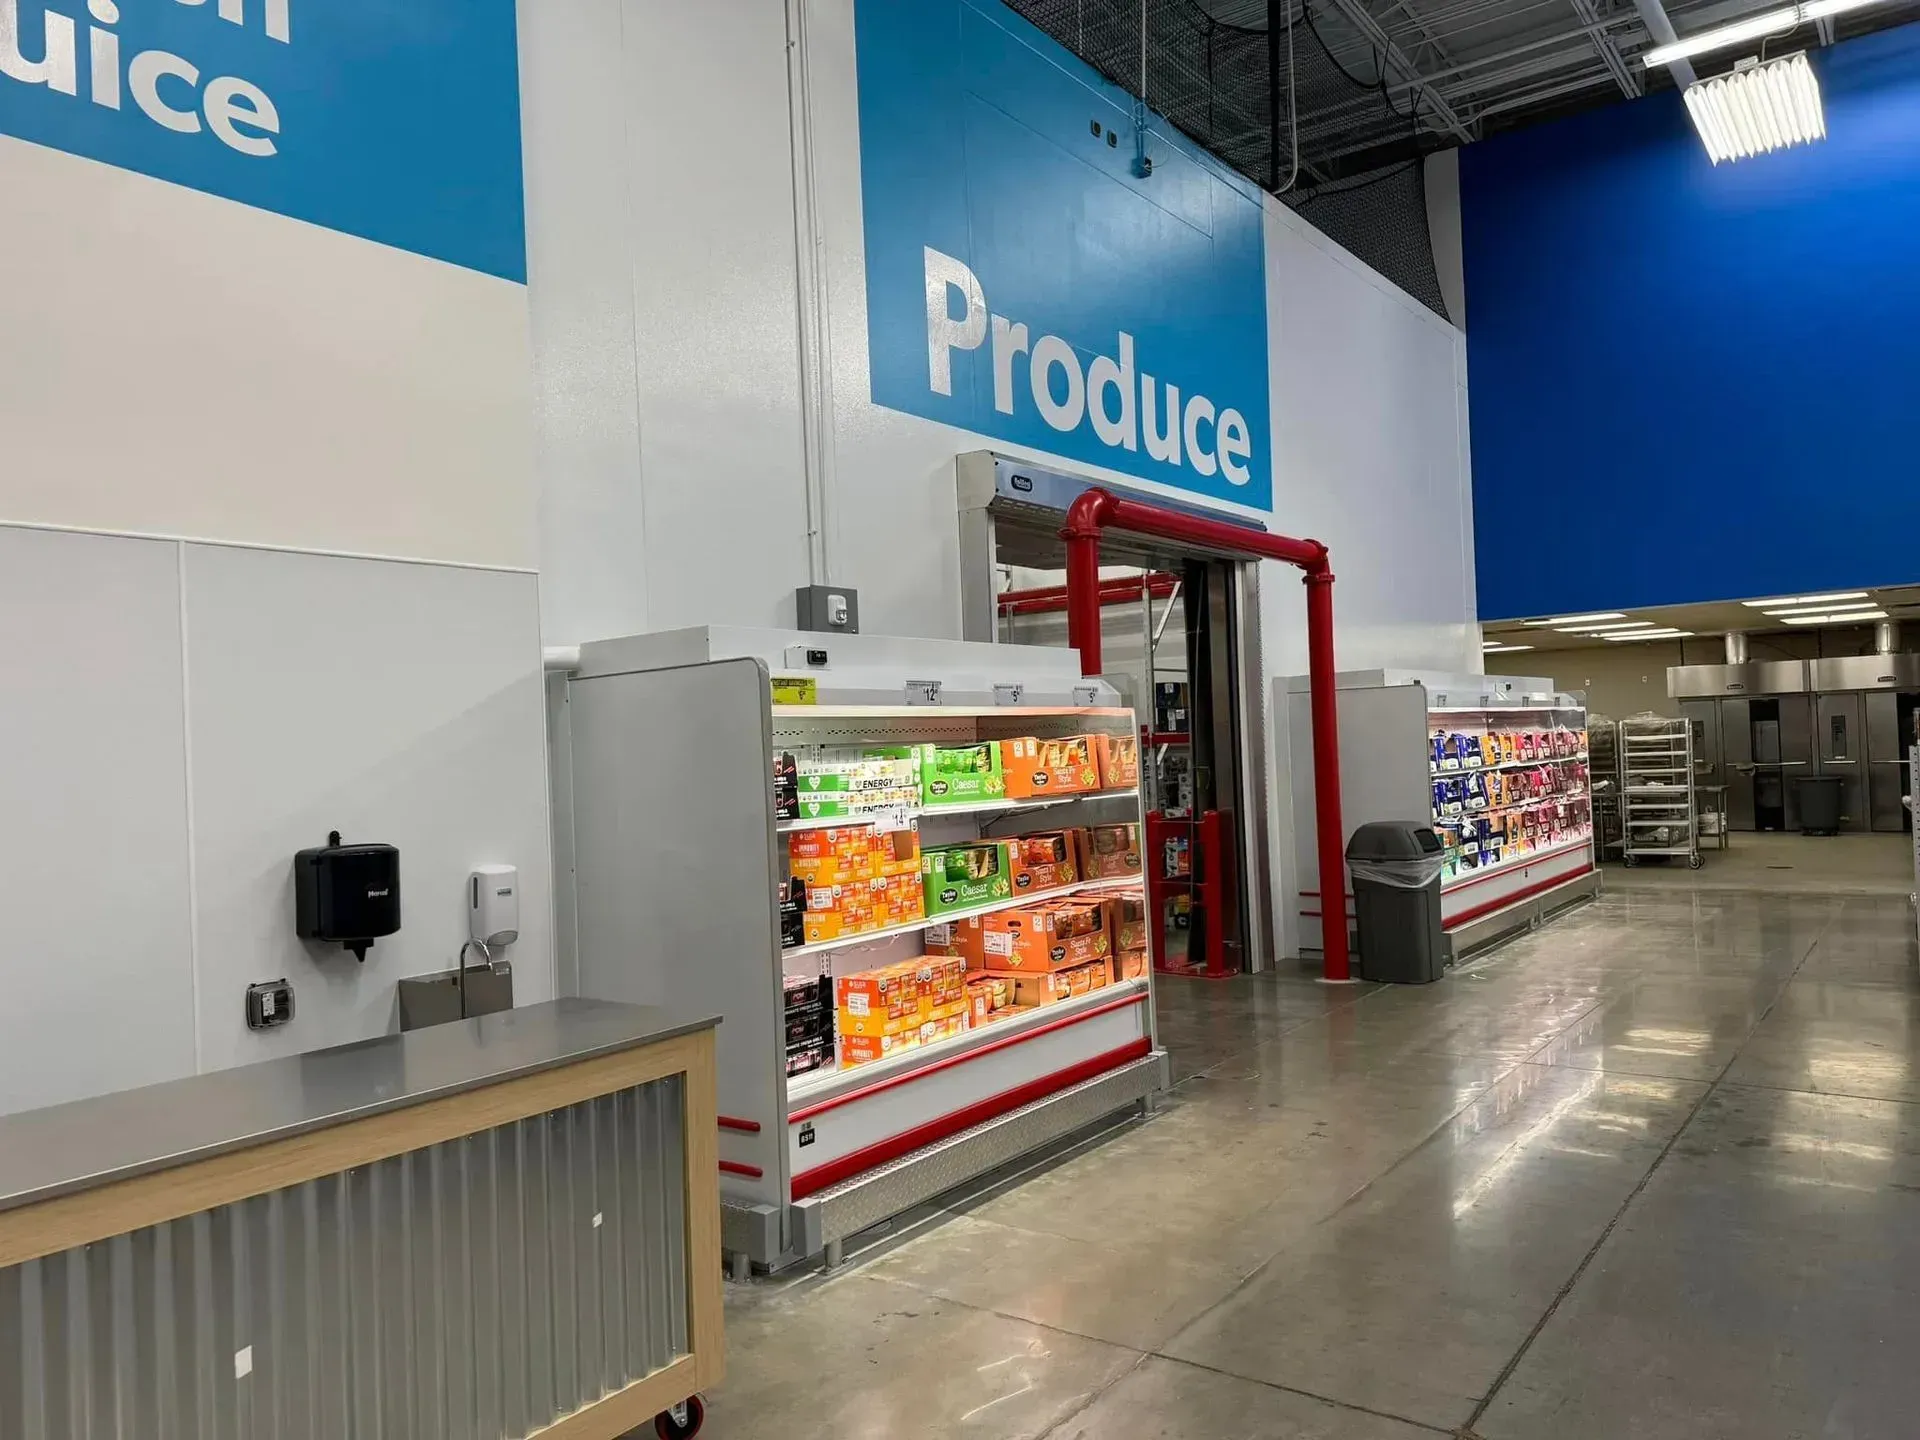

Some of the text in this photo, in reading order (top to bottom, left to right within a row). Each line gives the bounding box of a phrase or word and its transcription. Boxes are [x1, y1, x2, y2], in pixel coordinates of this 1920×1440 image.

[924, 245, 1252, 487] Produce
[862, 778, 894, 789] ENERGY
[952, 777, 980, 791] Caesar
[961, 883, 988, 897] Caesar
